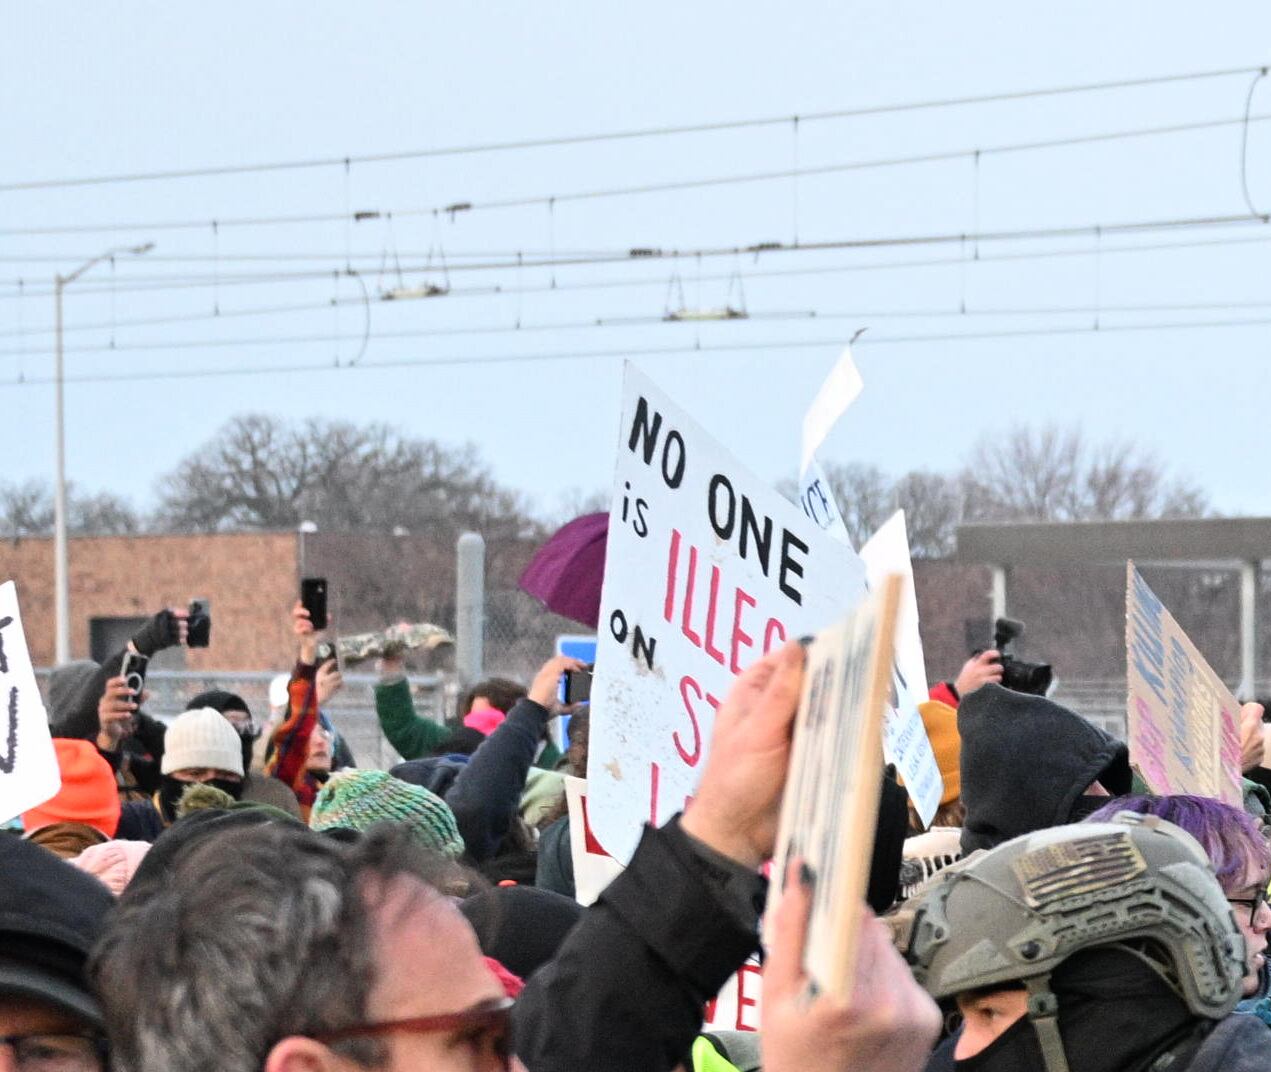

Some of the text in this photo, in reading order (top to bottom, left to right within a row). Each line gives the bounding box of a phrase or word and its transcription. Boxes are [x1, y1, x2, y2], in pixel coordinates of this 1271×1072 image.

[628, 396, 810, 607] NO ONE
[609, 608, 657, 672] ON
